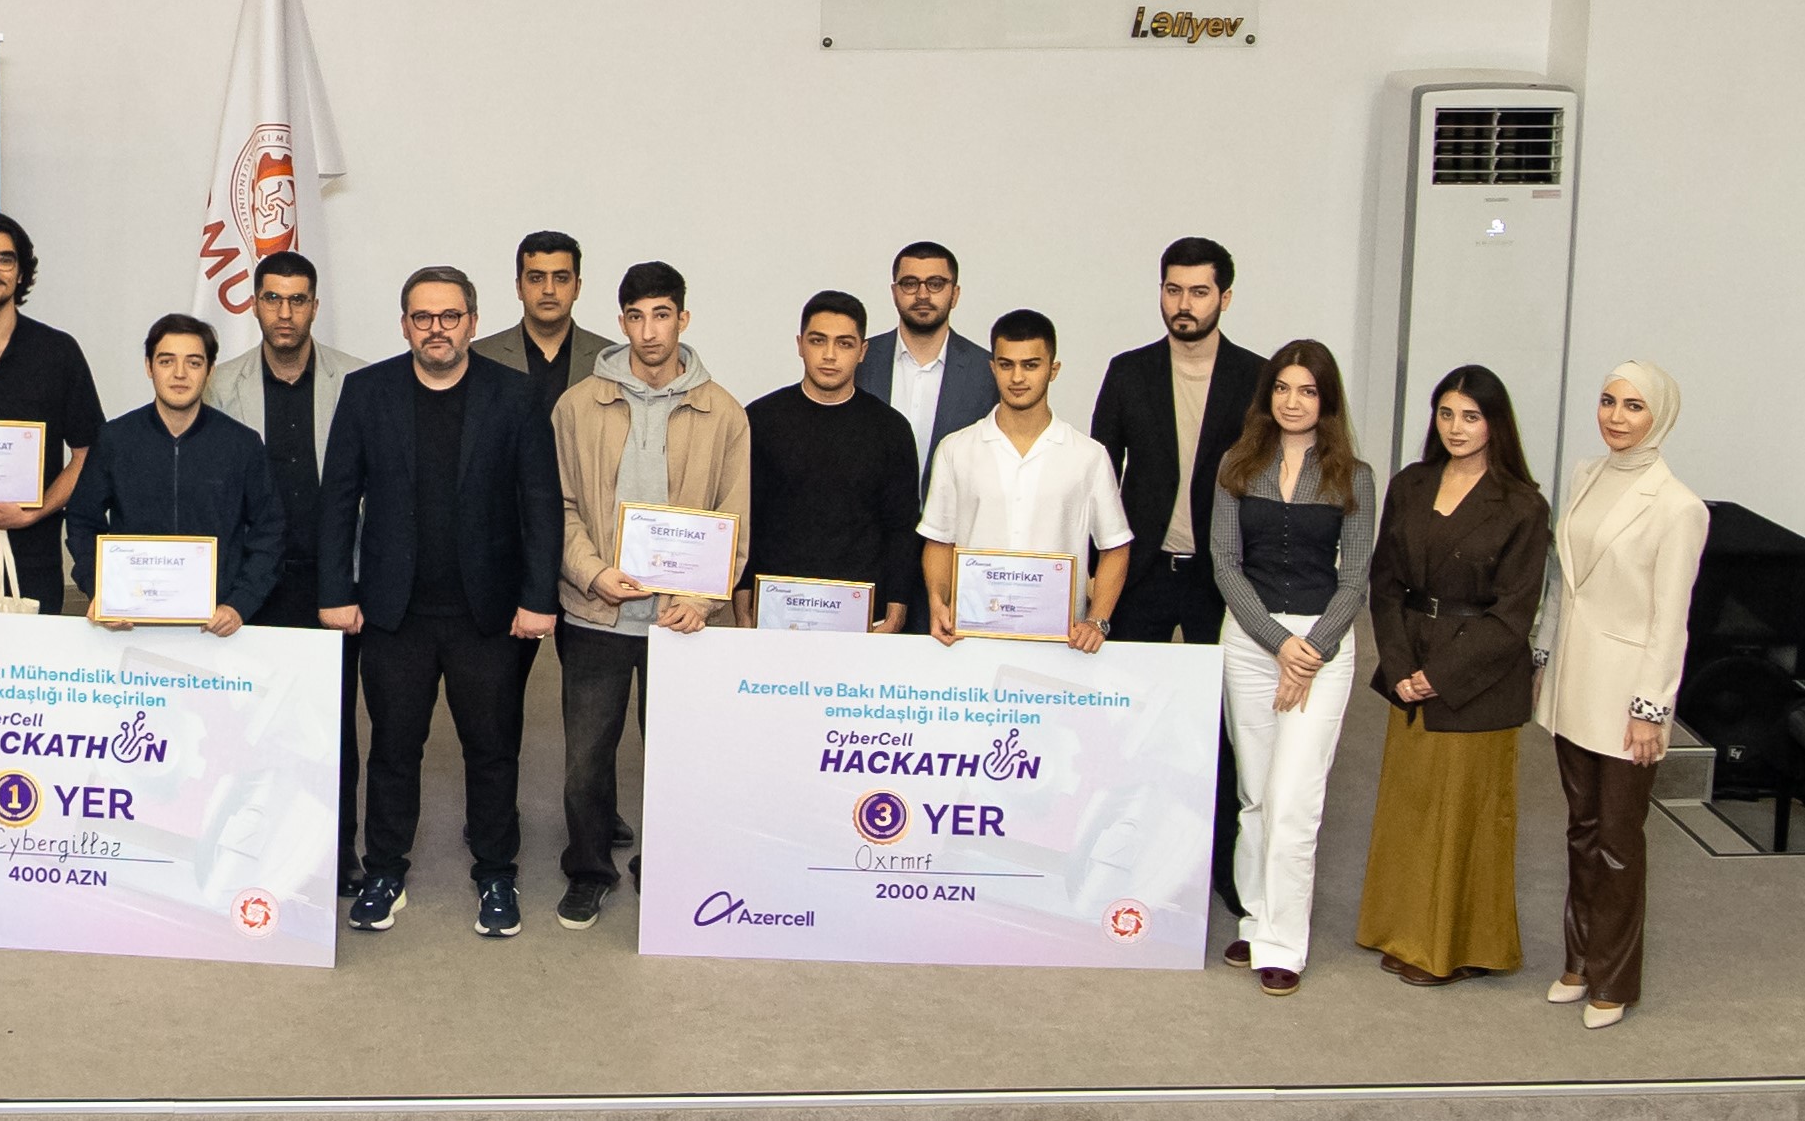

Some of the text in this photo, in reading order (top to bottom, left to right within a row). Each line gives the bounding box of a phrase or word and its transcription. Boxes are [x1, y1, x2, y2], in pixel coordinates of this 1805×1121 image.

[200, 220, 255, 314] MU
[650, 526, 706, 540] SERTİFİKAT
[130, 555, 185, 566] SERTİFİKAT
[986, 571, 1043, 582] SERTİFİKAT
[786, 597, 841, 609] SERTİFİKAT
[11, 665, 116, 684] Mühəndislik
[121, 671, 252, 691] Universitetinin
[67, 688, 87, 702] ilə
[93, 689, 166, 708] keçirilən
[737, 680, 1130, 707] Azercell və Bakı Mühəndislik Universitetinin
[825, 704, 1040, 726] əməkdaşlığı ilə keçirilən
[826, 730, 913, 747] CyberCell
[7, 784, 135, 821] 1 YER
[874, 803, 1006, 837] 3 YER
[8, 866, 107, 887] 4000 AZN
[875, 883, 976, 902] 2000 AZN
[738, 908, 815, 927] Azercell
